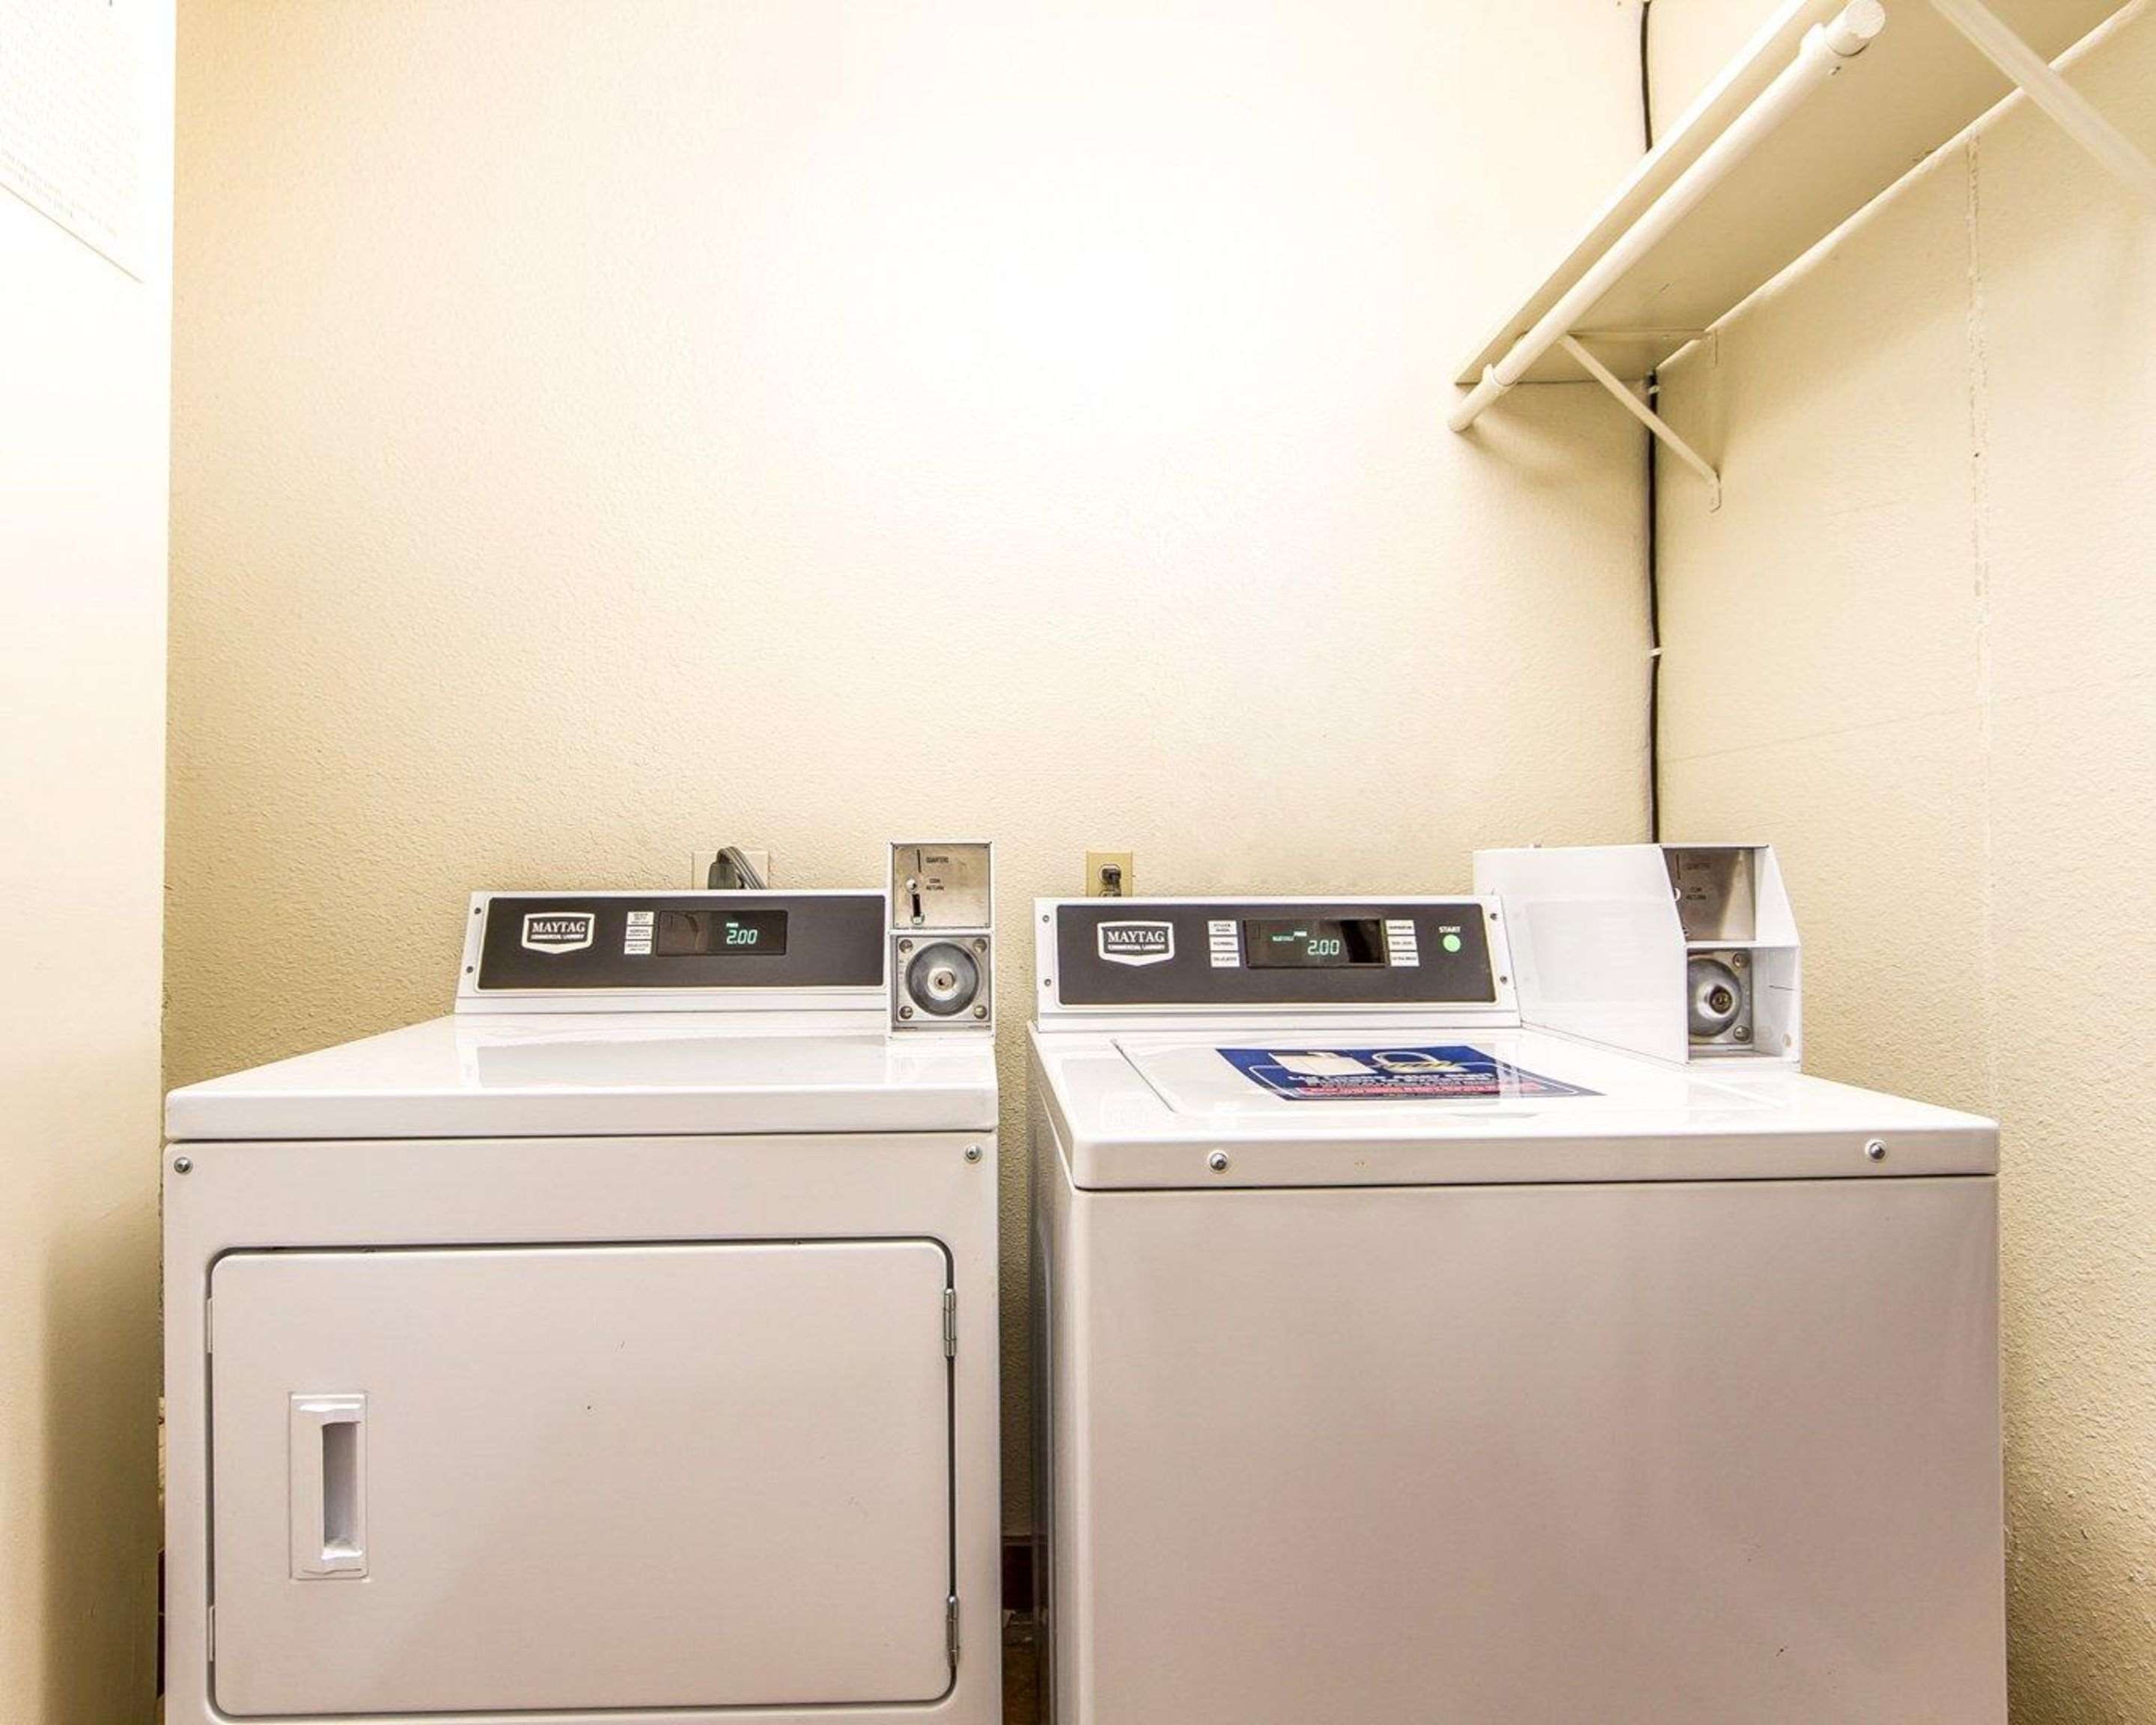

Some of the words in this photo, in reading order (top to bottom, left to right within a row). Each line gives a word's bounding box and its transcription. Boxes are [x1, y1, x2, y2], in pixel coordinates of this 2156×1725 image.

[532, 921, 586, 933] MAYTAG
[1438, 925, 1461, 934] START
[726, 929, 758, 944] 2.00
[1107, 931, 1166, 943] MAYTAG
[1308, 940, 1340, 955] 2.00
